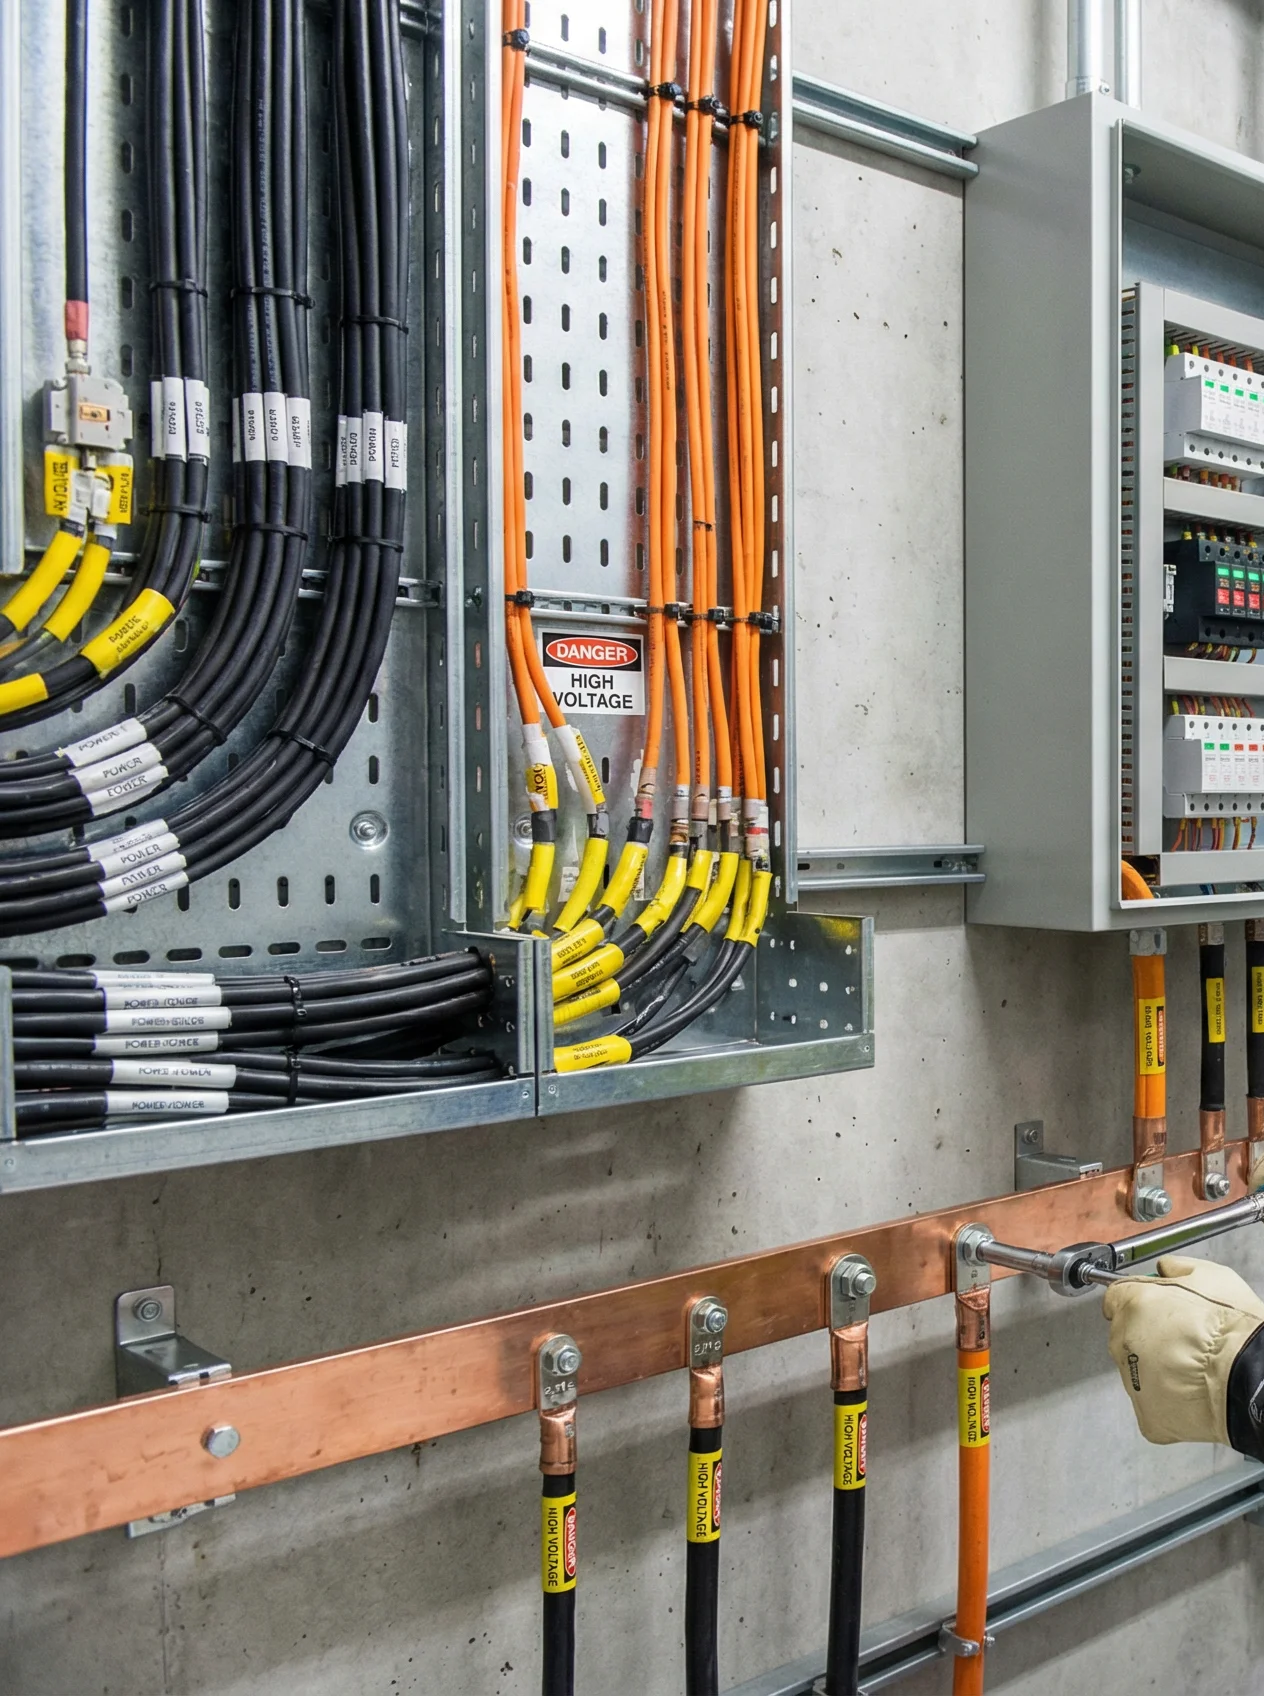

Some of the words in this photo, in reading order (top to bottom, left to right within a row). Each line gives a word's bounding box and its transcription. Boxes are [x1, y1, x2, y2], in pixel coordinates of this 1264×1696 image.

[556, 643, 628, 662] DANGER
[571, 673, 614, 690] HIGH
[553, 691, 634, 709] VOLTAGE
[547, 1537, 559, 1587] VOLTAGE
